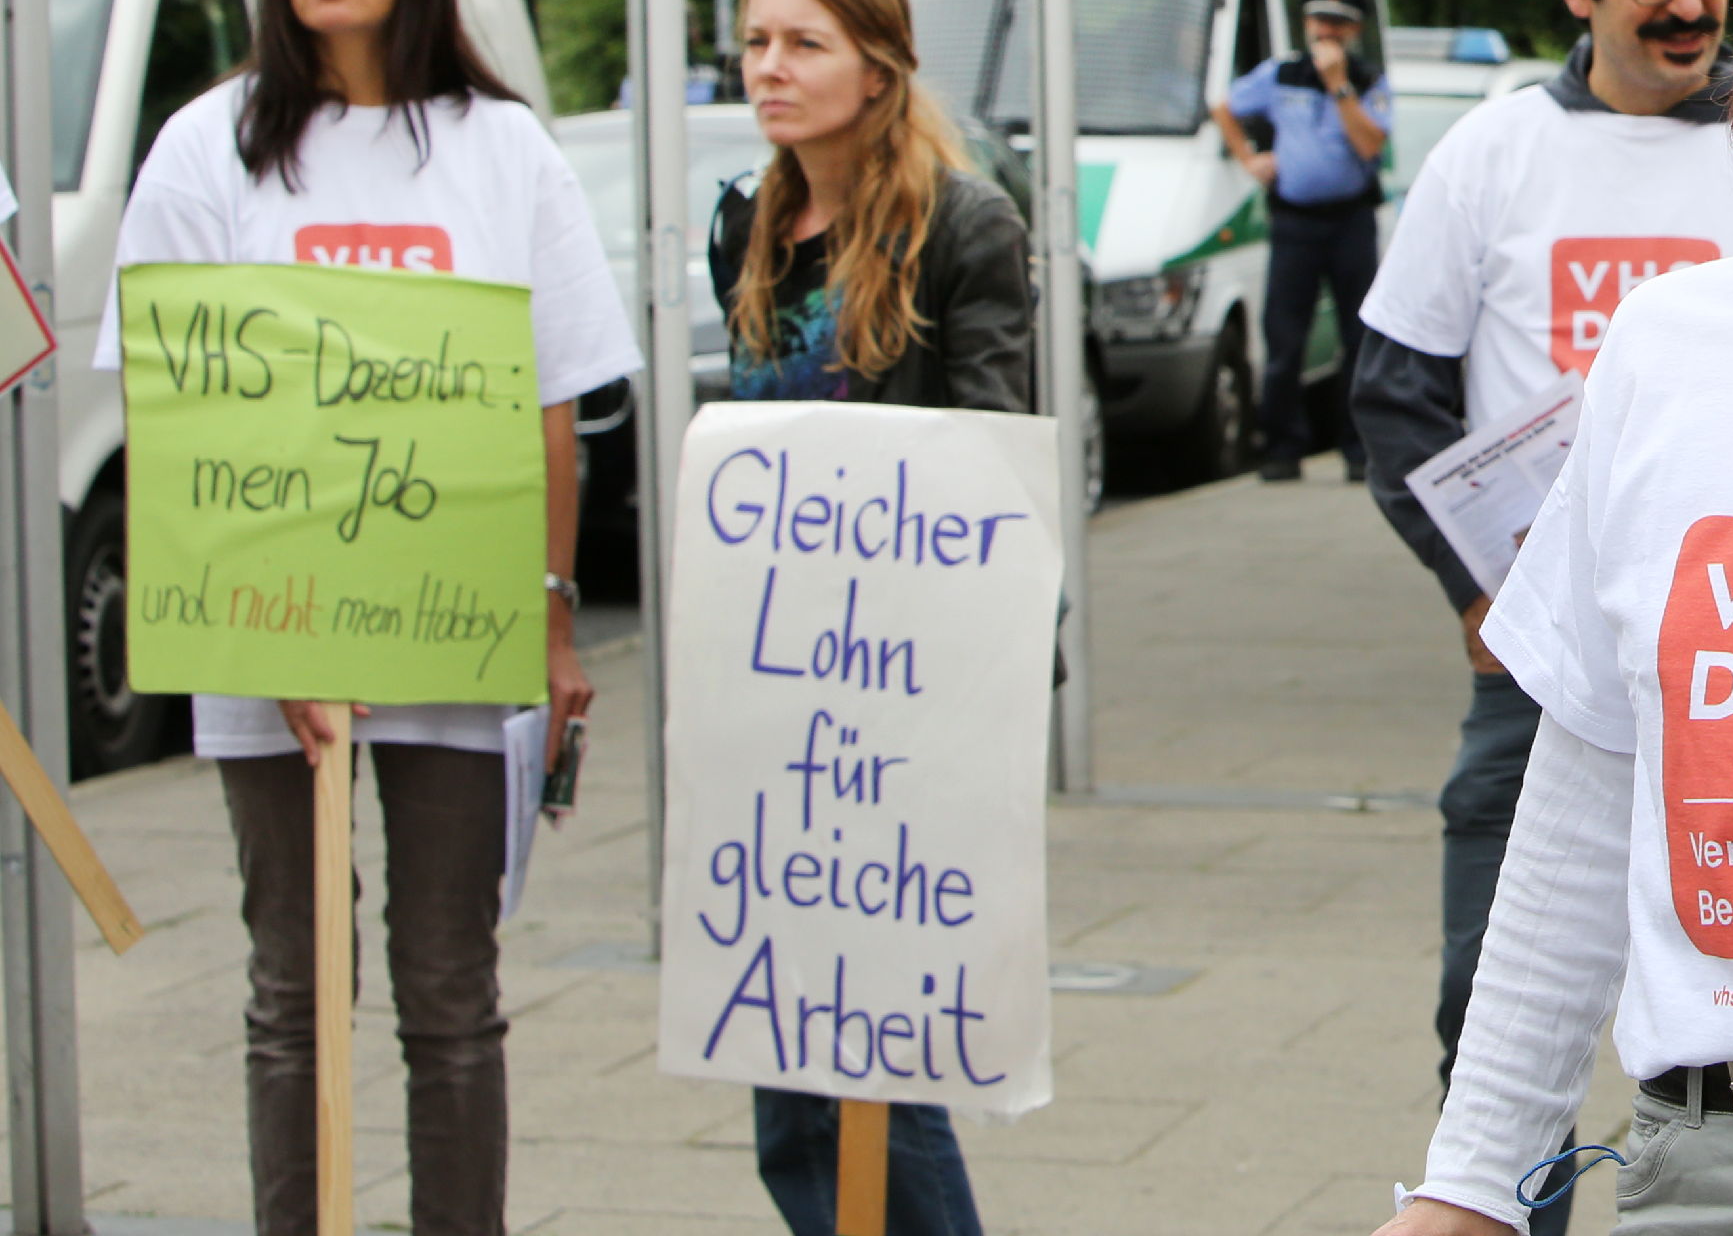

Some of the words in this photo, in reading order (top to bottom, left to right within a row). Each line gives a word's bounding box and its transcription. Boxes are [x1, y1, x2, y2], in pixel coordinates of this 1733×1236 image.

[1568, 260, 1698, 302] VH
[193, 456, 311, 512] mein
[335, 435, 437, 543] Job
[706, 447, 1028, 565] Gleicher
[141, 564, 218, 627] und
[228, 575, 323, 637] nicht
[412, 571, 520, 682] Hobby
[751, 566, 922, 695] Lohn
[787, 710, 909, 831] für
[699, 792, 974, 946] gleiche
[704, 936, 1006, 1085] Arbeit
